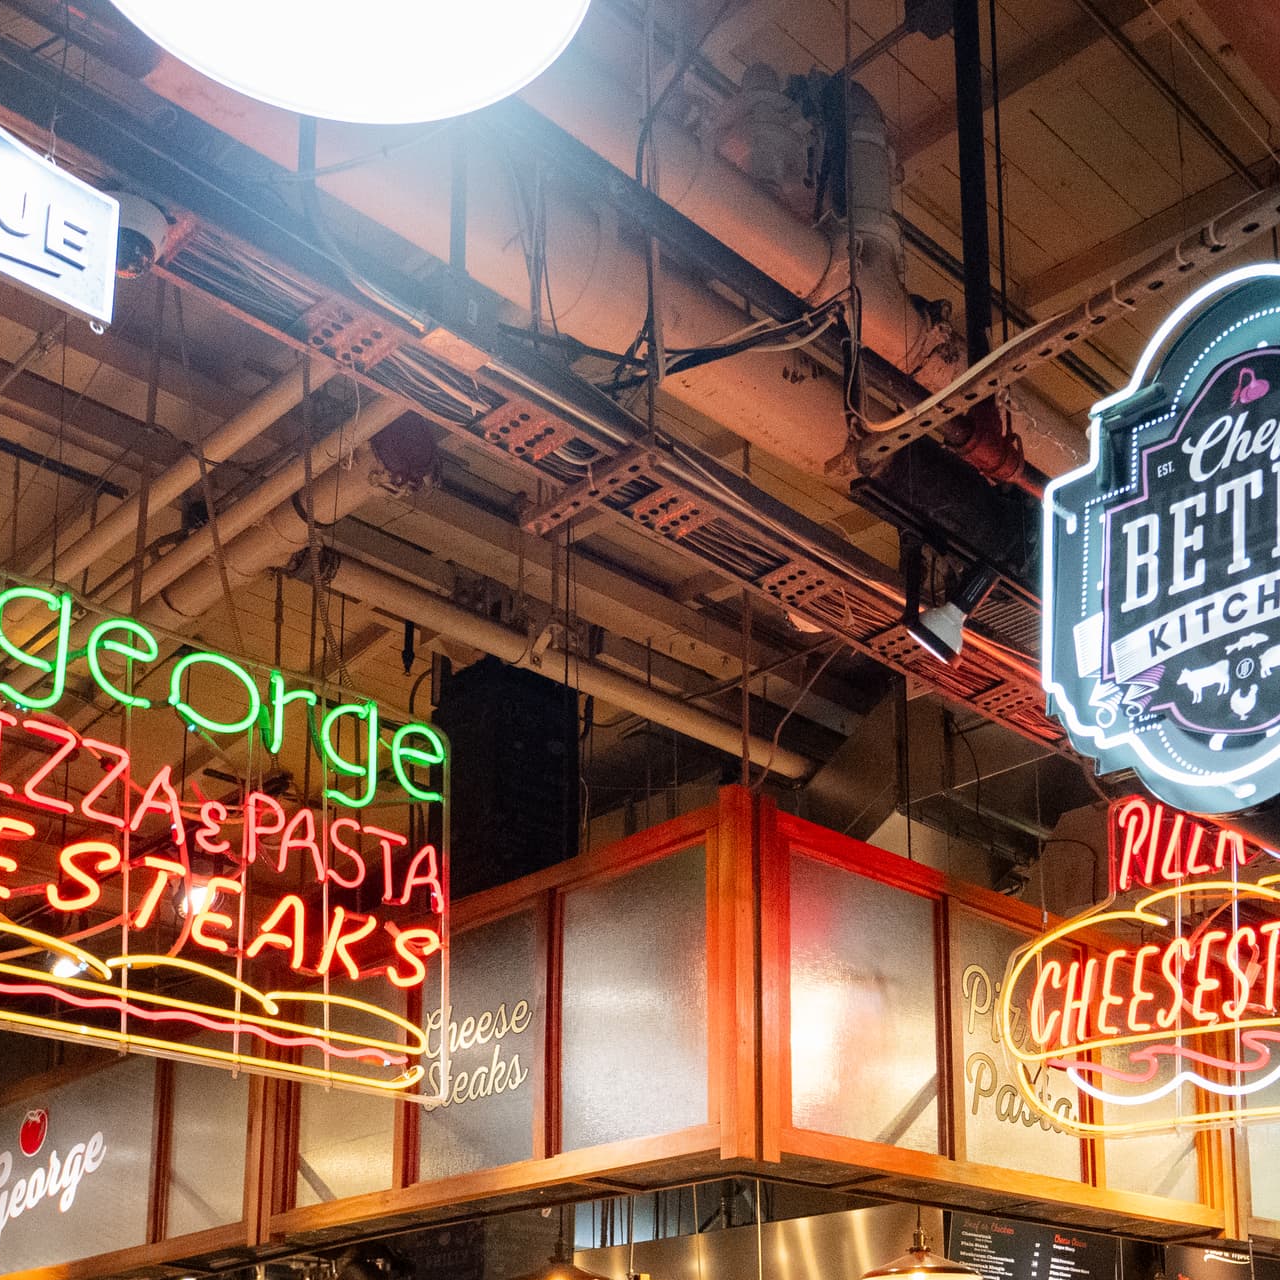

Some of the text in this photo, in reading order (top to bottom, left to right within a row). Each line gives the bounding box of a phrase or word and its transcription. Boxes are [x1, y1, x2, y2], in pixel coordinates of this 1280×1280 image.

[1156, 461, 1176, 478] EST.
[194, 797, 231, 854] &
[242, 790, 445, 912] PASTA
